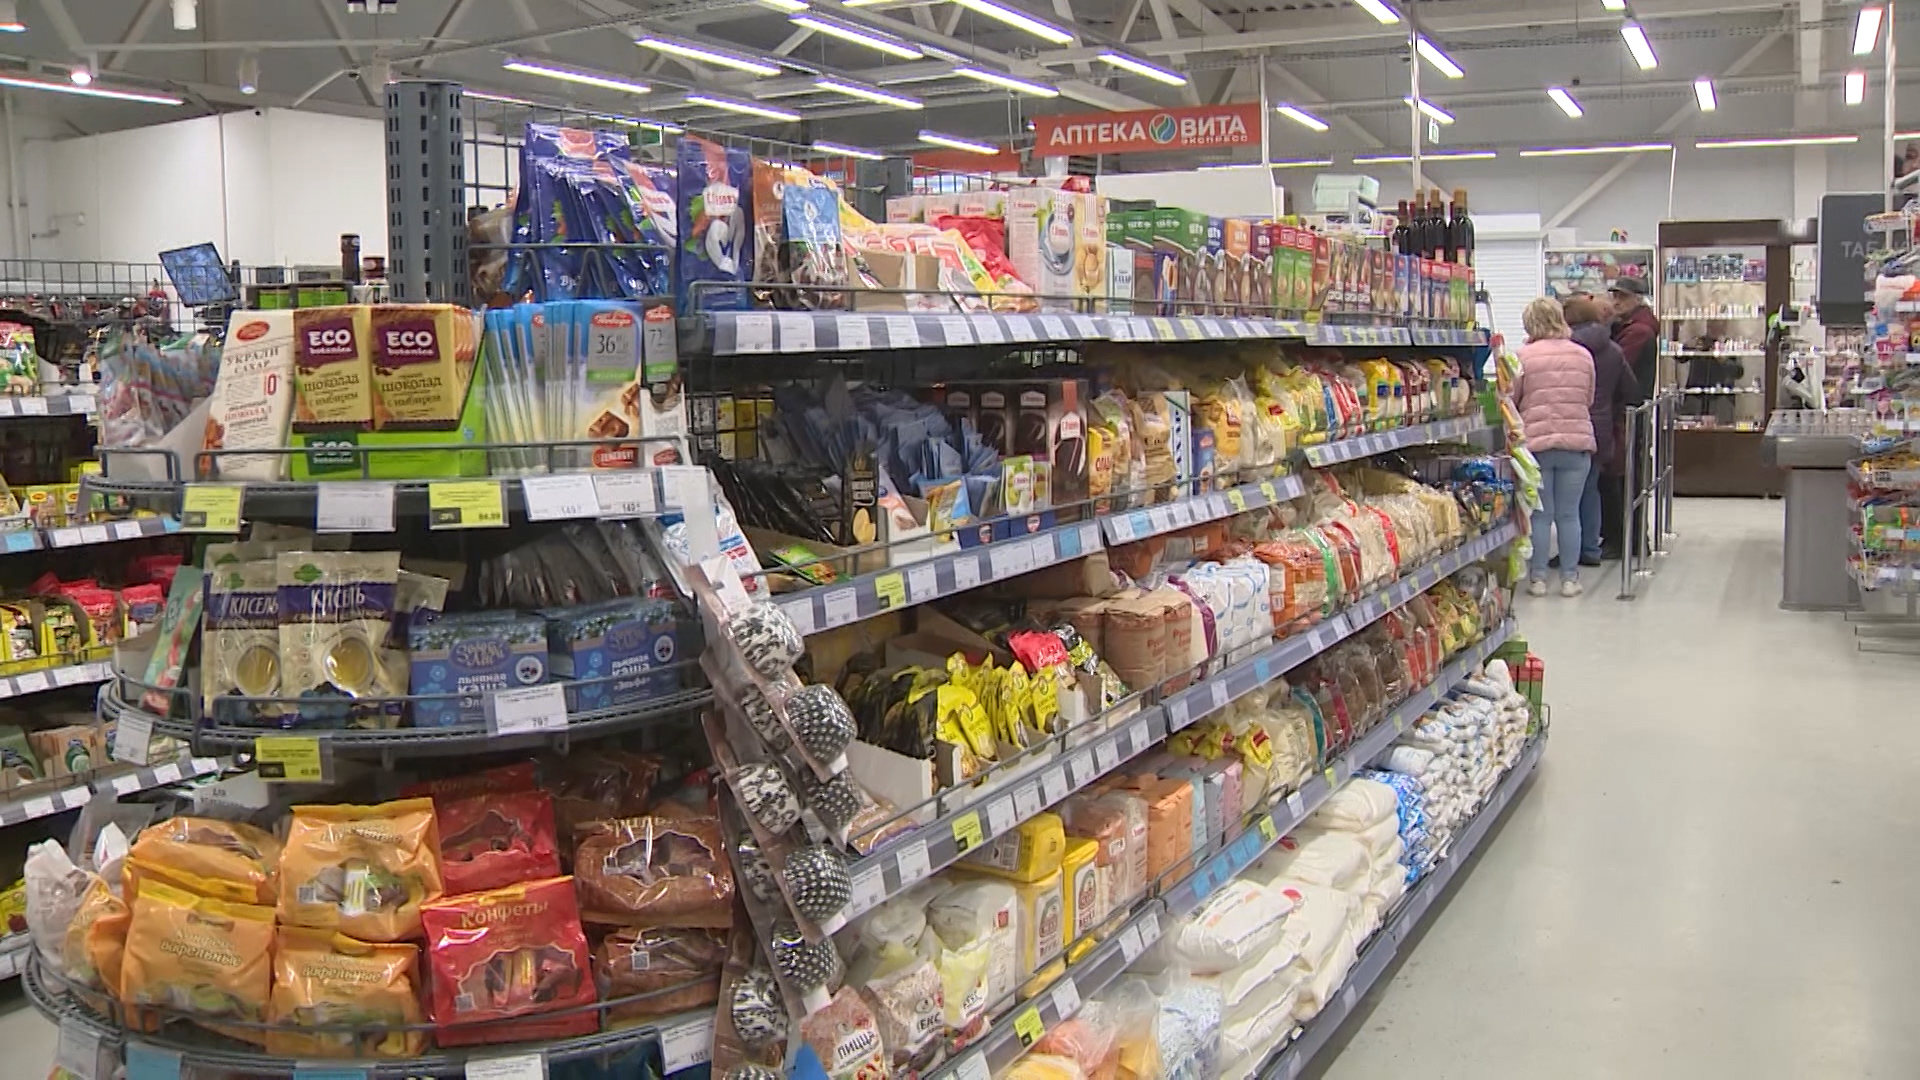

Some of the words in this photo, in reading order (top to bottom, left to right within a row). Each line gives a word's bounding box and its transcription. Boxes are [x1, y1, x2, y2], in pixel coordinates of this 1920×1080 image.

[1050, 121, 1147, 146] АПТЕКА
[1180, 114, 1247, 137] ВИТА
[308, 329, 351, 346] ECO
[386, 331, 433, 347] ECO
[229, 596, 279, 615] КИСЕЛЬ
[311, 587, 365, 608] КИСЕЛЬ
[460, 901, 548, 928] Конфеты
